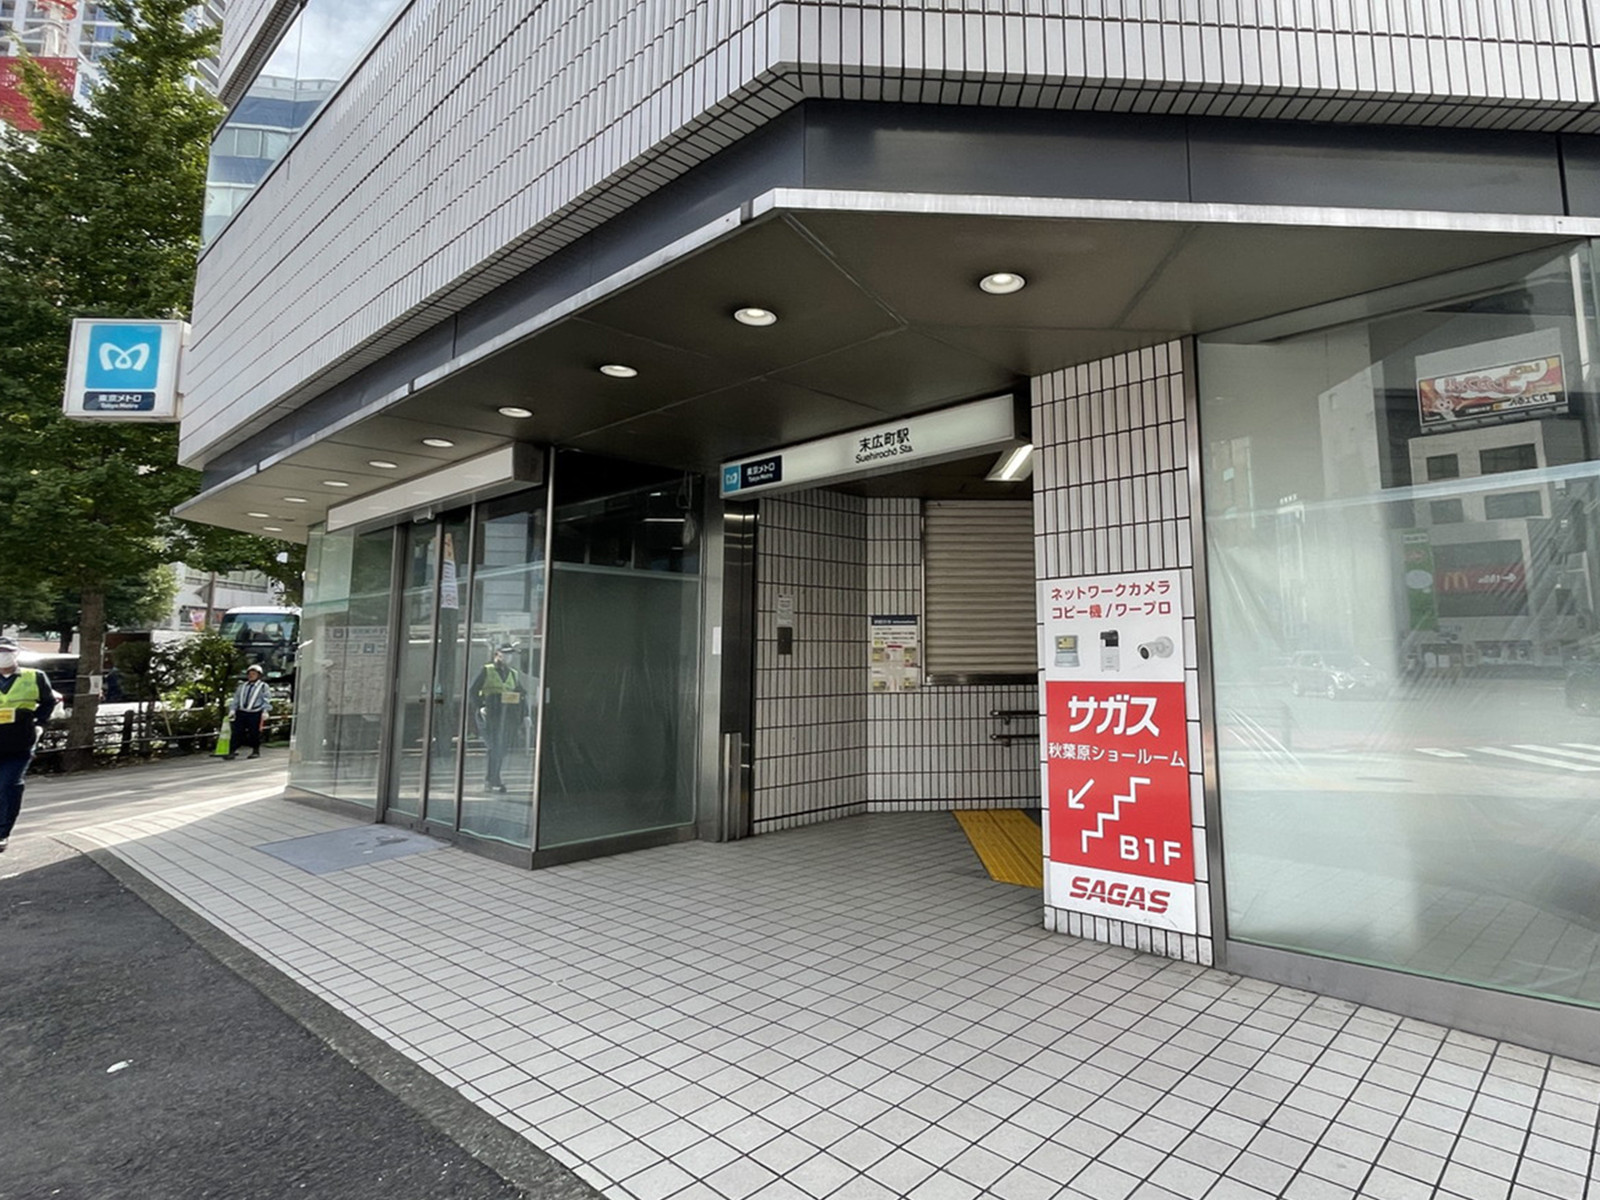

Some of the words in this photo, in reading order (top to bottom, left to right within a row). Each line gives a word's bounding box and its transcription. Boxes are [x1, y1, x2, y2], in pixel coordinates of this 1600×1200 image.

[859, 427, 910, 453] 末広町駅
[1051, 580, 1170, 601] ネットワークカメラ
[1067, 693, 1160, 737] サガス
[1048, 742, 1186, 767] 秋葉原ショールーム
[1119, 835, 1182, 866] B1F
[1069, 876, 1171, 914] SAGAS
